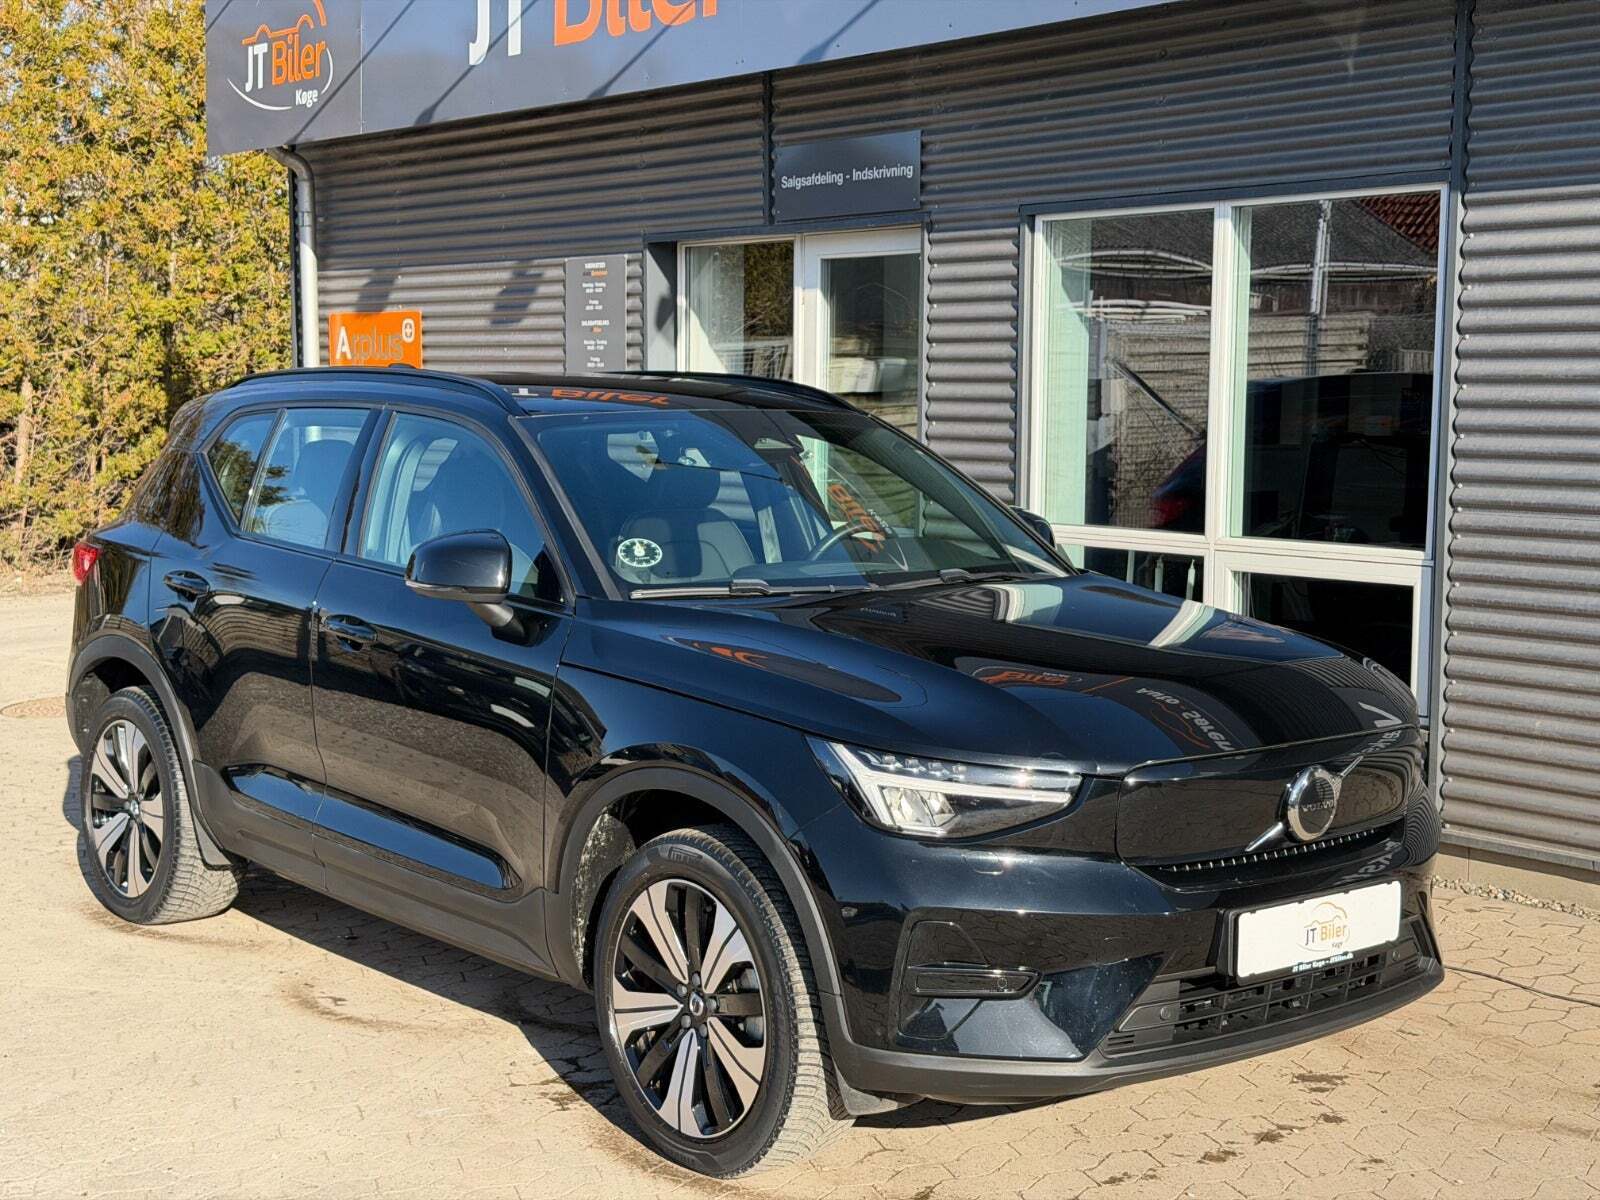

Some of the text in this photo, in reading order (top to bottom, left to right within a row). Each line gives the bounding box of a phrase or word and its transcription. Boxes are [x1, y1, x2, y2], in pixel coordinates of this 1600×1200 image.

[245, 33, 326, 93] JT Biler
[295, 88, 319, 108] Køge
[780, 170, 844, 190] Salgsafdeling
[852, 163, 914, 182] Indskrivning
[1305, 926, 1318, 946] JT
[1320, 922, 1347, 941] Biler
